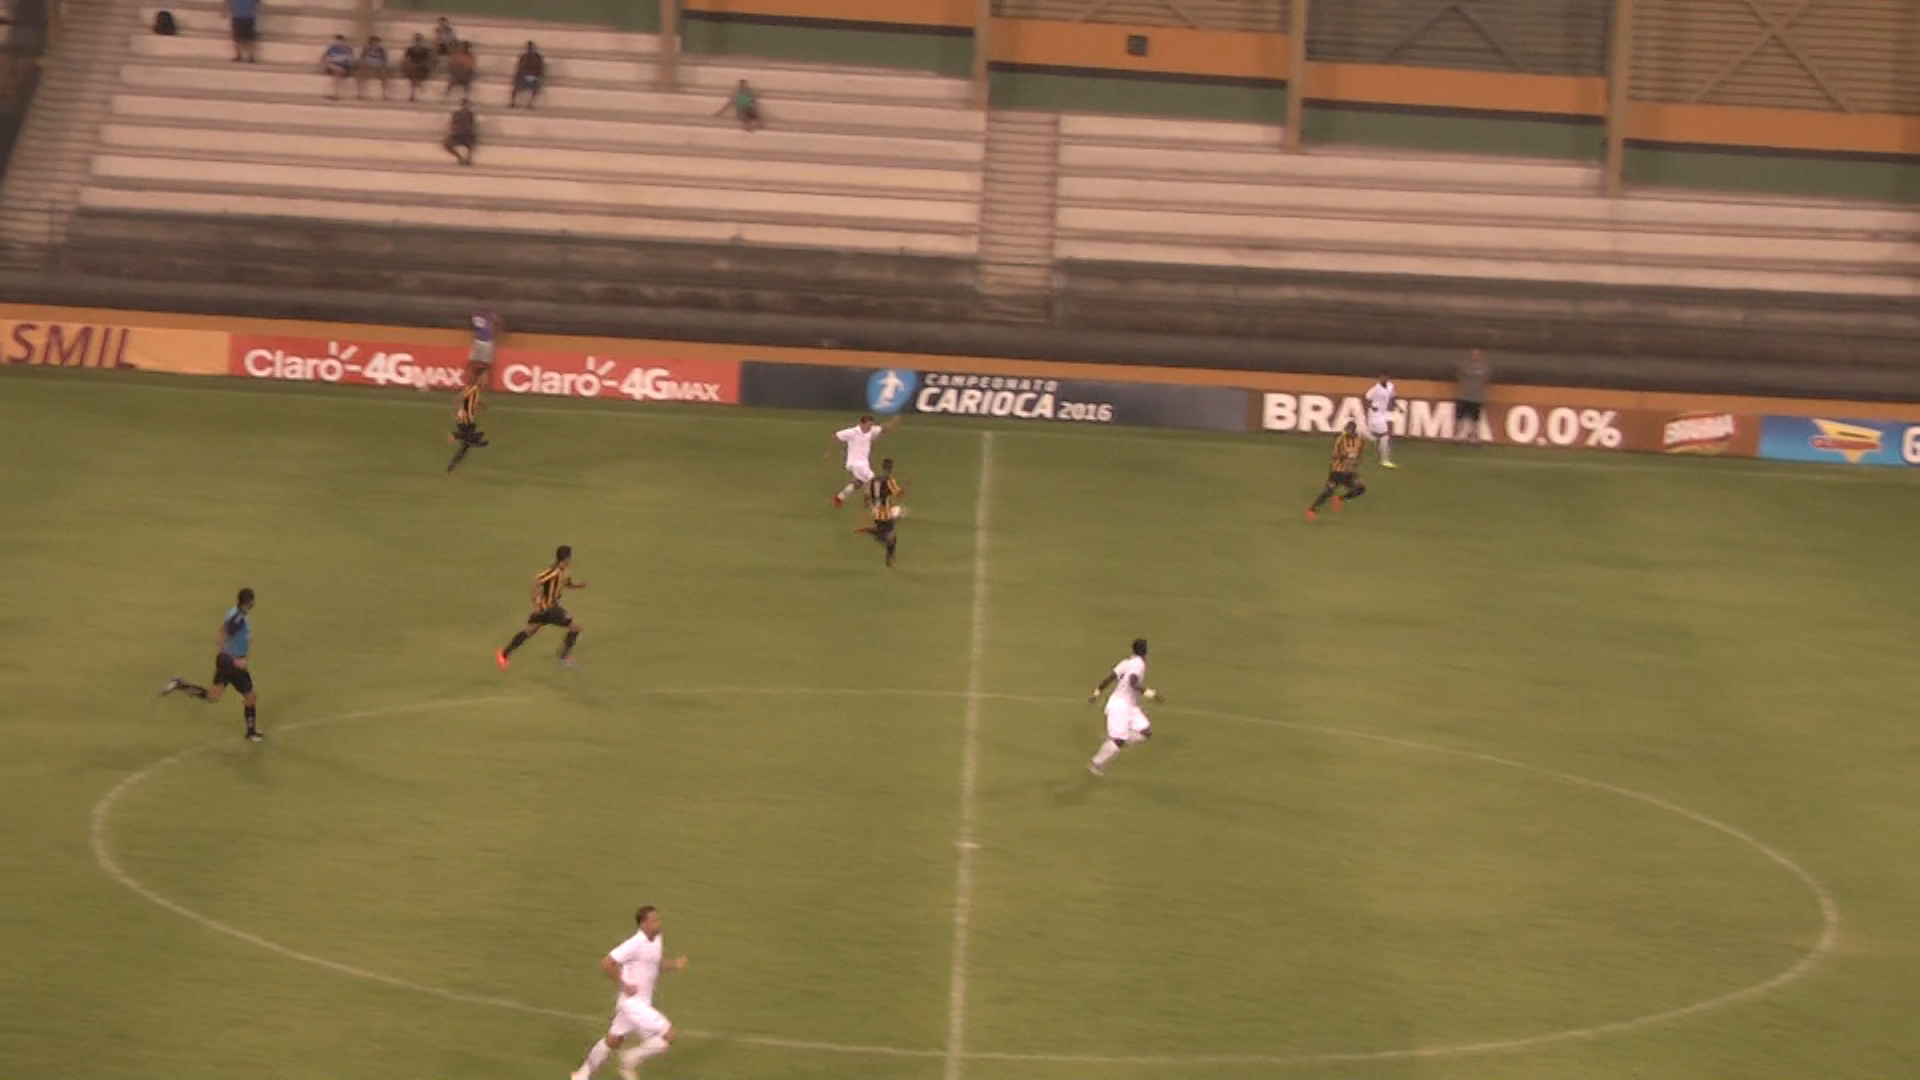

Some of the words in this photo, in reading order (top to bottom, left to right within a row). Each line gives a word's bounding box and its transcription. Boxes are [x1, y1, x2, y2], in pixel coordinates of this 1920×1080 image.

[0, 322, 136, 370] SMIL
[244, 348, 343, 383] Claro
[502, 363, 601, 397] Claro
[924, 372, 1059, 391] CAMPEONATO
[915, 386, 1054, 419] CARIOCA
[1056, 400, 1113, 422] 2016
[1505, 404, 1623, 448] 0.0%
